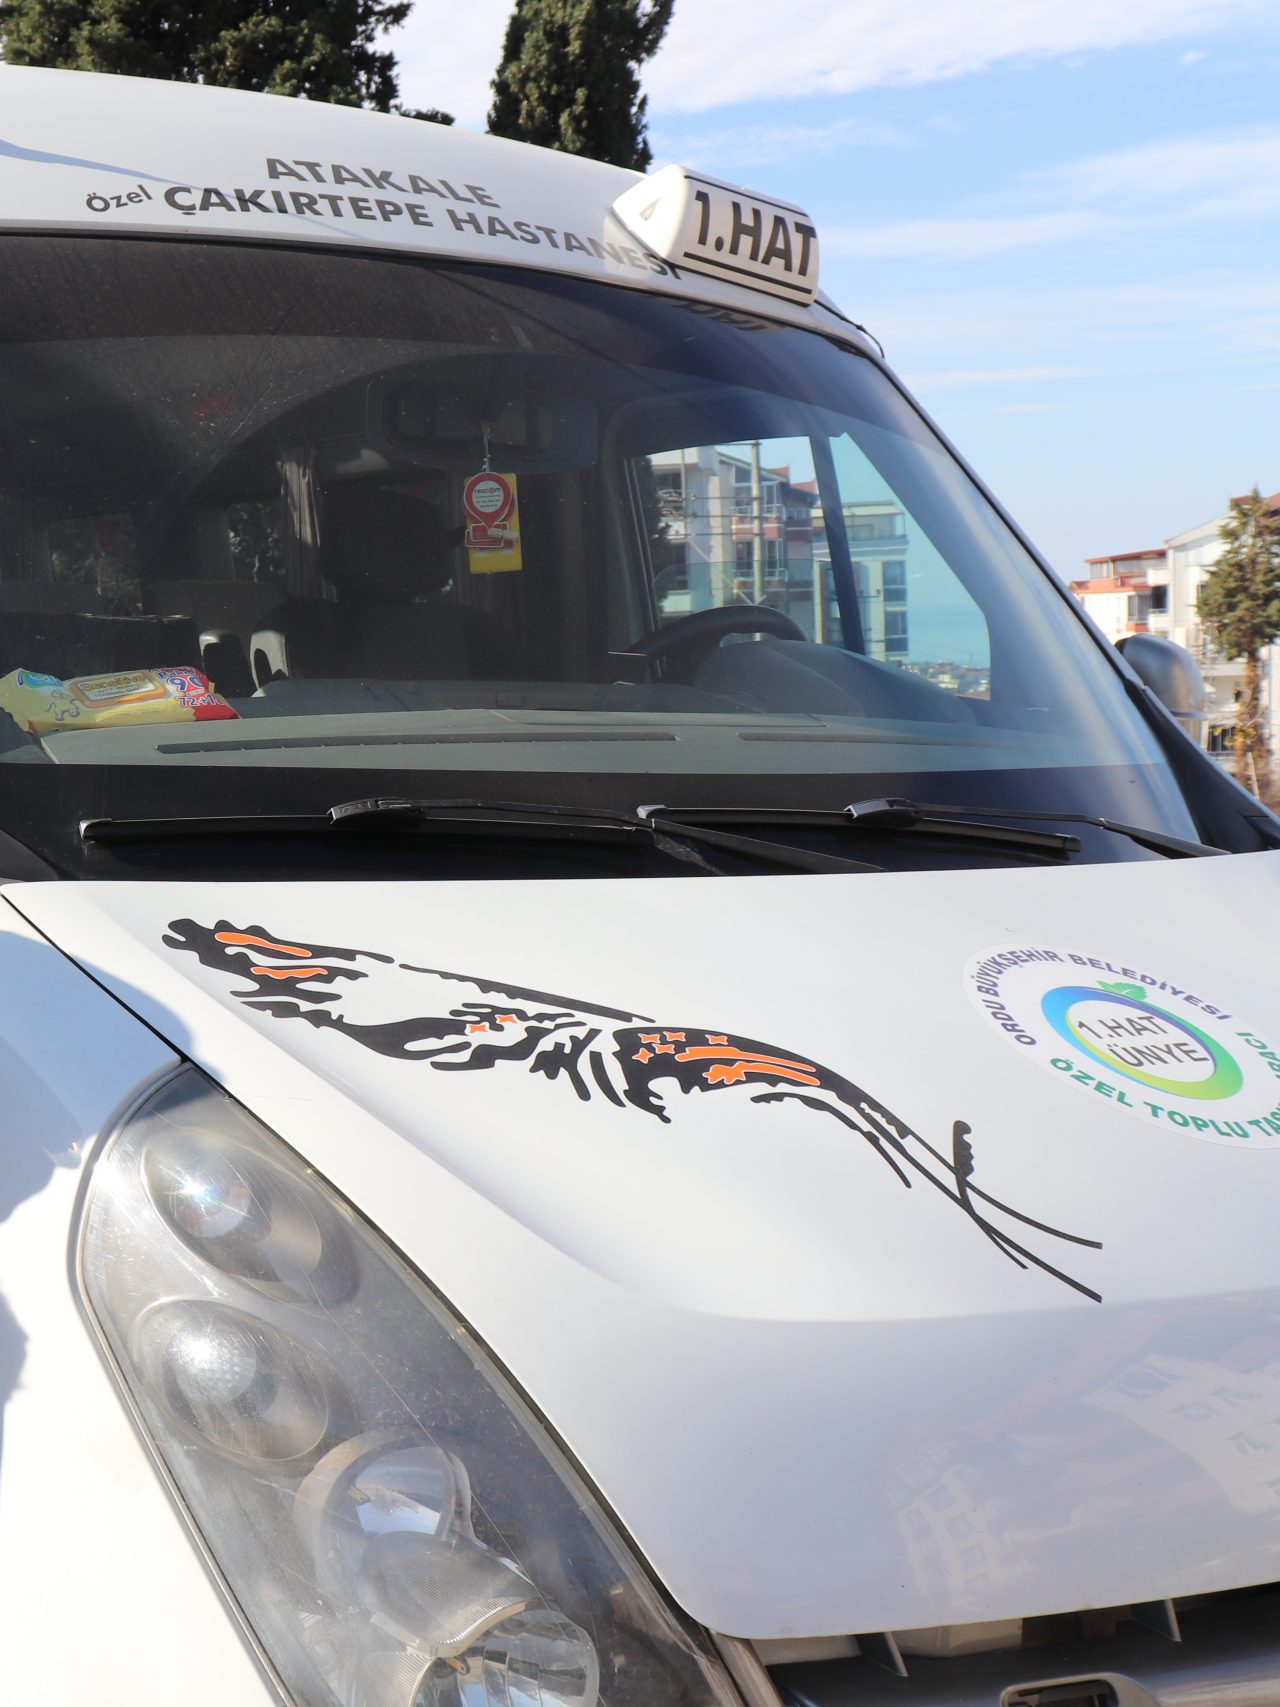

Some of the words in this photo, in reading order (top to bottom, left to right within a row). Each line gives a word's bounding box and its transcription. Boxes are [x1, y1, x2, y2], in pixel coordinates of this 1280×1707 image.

[86, 184, 153, 212] Özel
[164, 186, 434, 227] ÇAKIRTEPE
[266, 158, 501, 208] ATAKALE
[695, 190, 817, 276] 1.HAT
[970, 946, 1065, 998] BÜYÜKŞEHİR
[1067, 953, 1232, 1020] BELEDİYESİ
[982, 998, 1038, 1046] ORDU
[1077, 1015, 1169, 1040] 1.HAT
[1107, 1042, 1211, 1068] ÜNYE
[1050, 1057, 1133, 1108] ÖZEL
[1142, 1101, 1251, 1139] TOPLU
